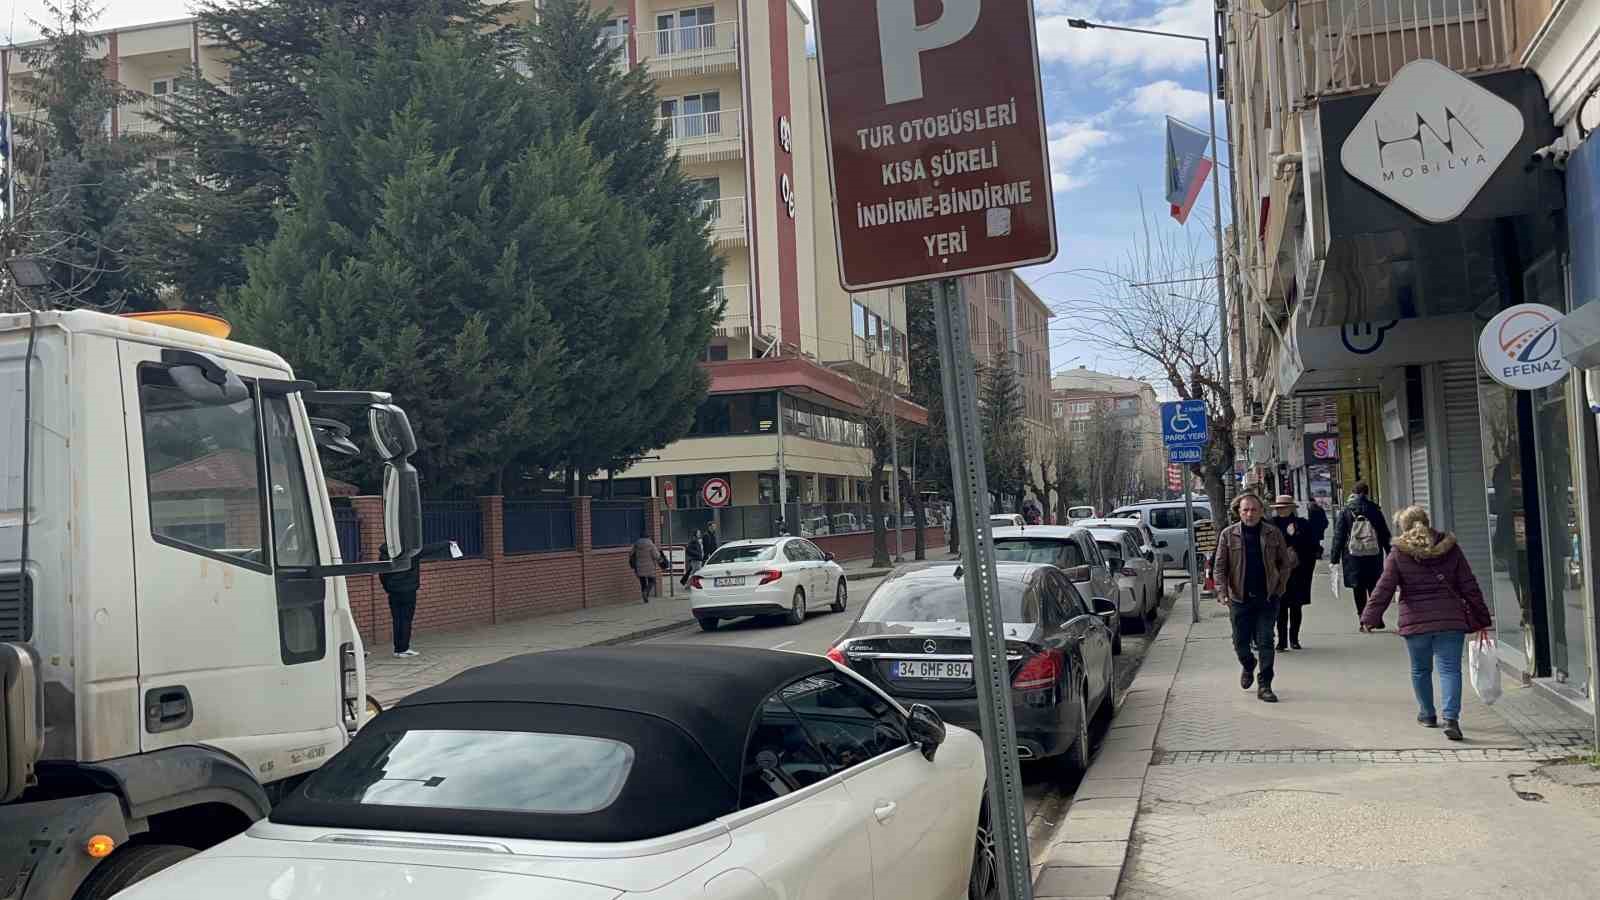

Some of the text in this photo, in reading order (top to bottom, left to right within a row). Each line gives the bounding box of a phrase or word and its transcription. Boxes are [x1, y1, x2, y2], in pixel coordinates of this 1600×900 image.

[876, 0, 981, 105] P
[856, 97, 1017, 150] TUR OTOBÜSLERİ
[881, 140, 999, 185] KISA SÜRELİ
[856, 180, 1032, 228] İNDİRME-BİNDİRME
[923, 225, 968, 256] YERİ
[1503, 359, 1562, 377] EFENAZ
[1165, 433, 1187, 441] PARK
[900, 662, 969, 677] 34 GMF 894
